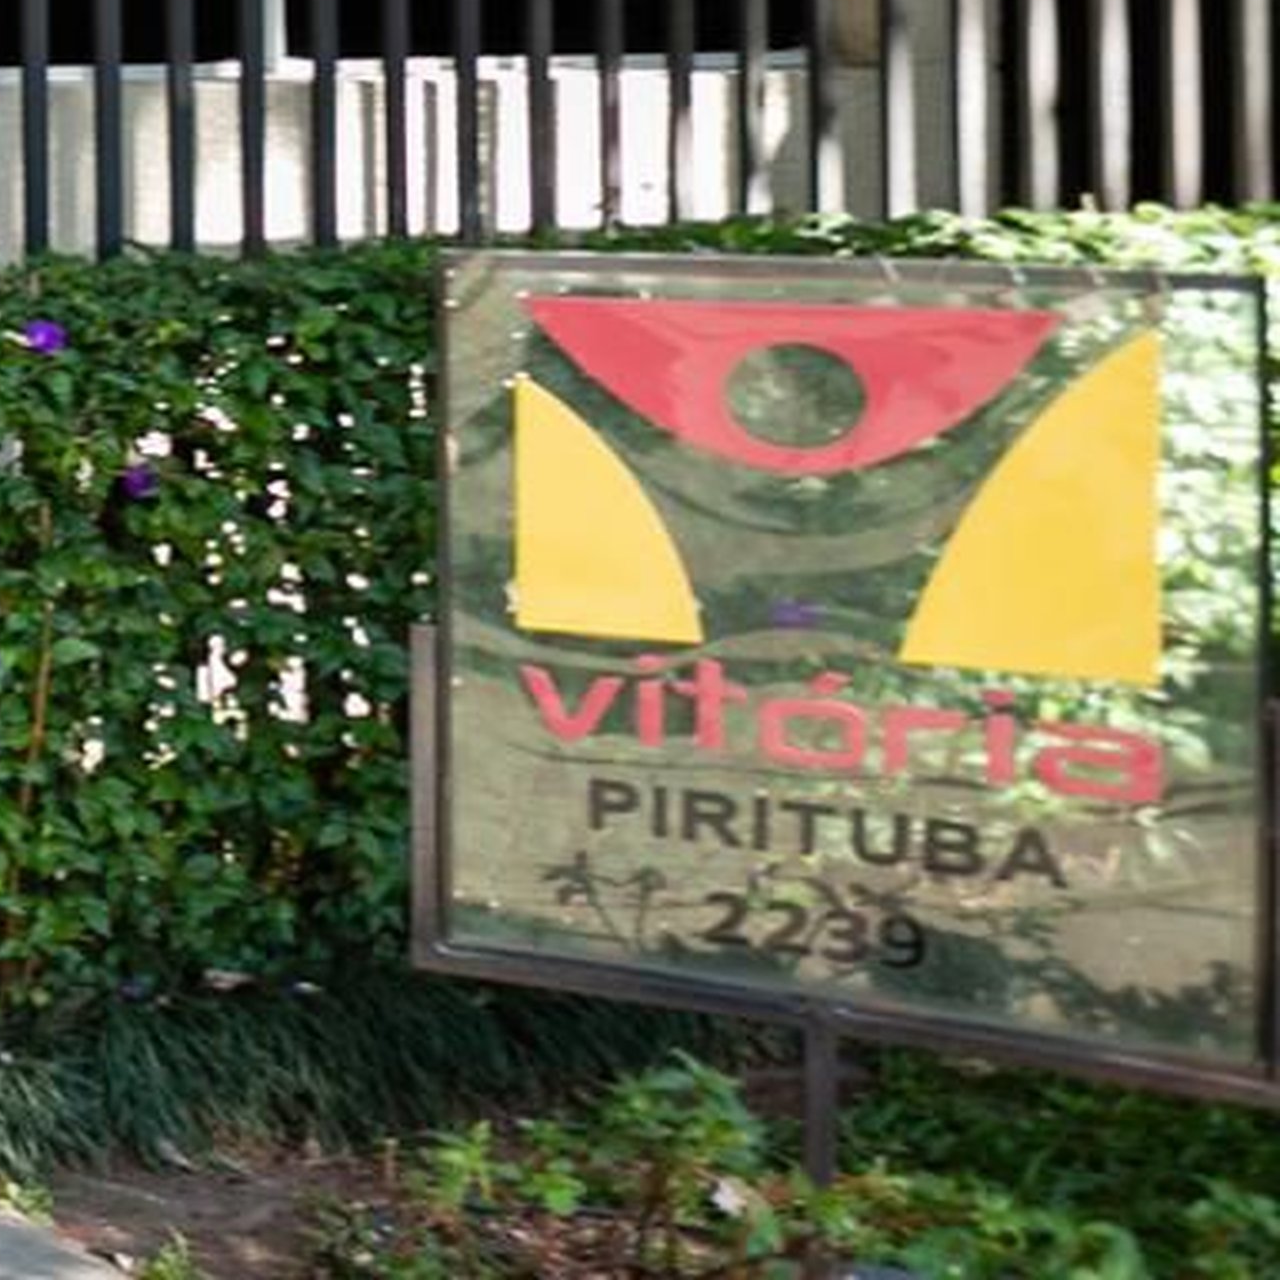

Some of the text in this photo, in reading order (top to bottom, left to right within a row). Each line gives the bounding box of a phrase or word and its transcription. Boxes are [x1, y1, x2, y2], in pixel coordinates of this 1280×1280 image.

[519, 653, 1163, 803] vitória
[587, 777, 1068, 889] PIRITUBA
[699, 891, 926, 970] 2239
